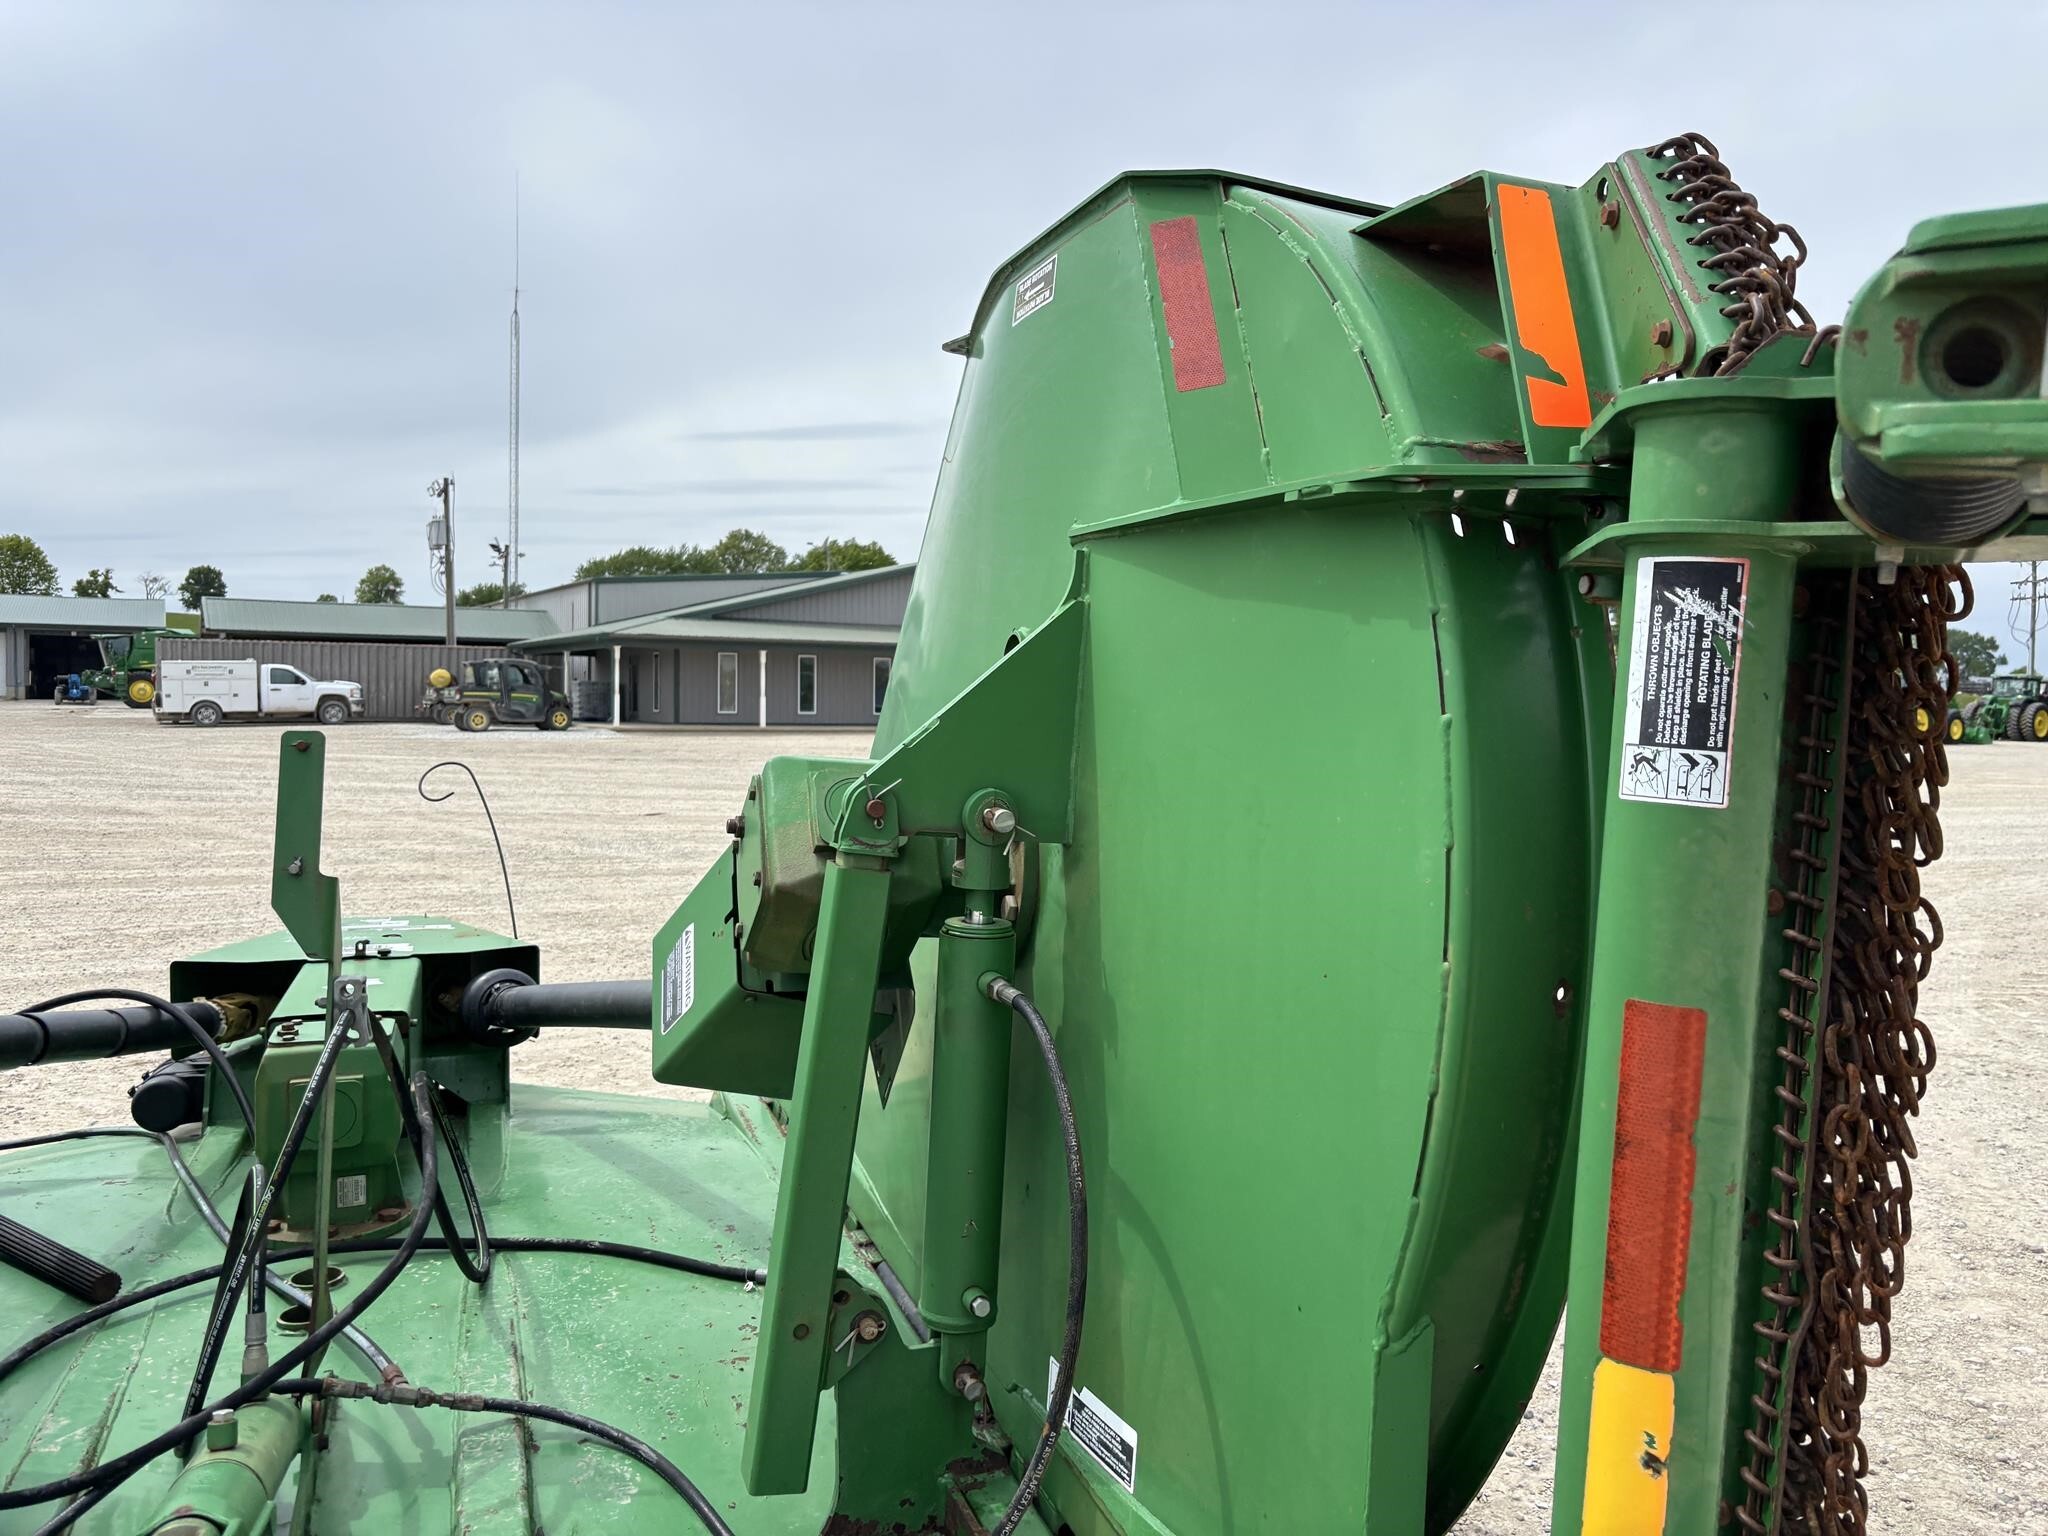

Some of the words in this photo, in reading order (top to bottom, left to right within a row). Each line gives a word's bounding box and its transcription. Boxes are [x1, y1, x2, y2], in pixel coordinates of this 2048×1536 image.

[1651, 604, 1663, 652] OBJECTS
[1673, 622, 1679, 630] of
[1680, 621, 1689, 654] Including
[1702, 607, 1714, 649] BLADE
[1670, 631, 1679, 666] hundreds
[1647, 655, 1658, 701] THROWN
[1656, 732, 1662, 743] Do
[1659, 690, 1667, 718] operate
[1663, 620, 1673, 647] people.
[1668, 667, 1676, 693] thrown
[1678, 656, 1686, 678] place.
[1686, 669, 1692, 677] at
[1697, 651, 1710, 703] ROTATING
[1708, 736, 1715, 747] Do
[1715, 675, 1720, 683] or
[1720, 587, 1728, 609] cutter
[1668, 694, 1673, 704] be
[1674, 687, 1682, 714] shields
[1683, 678, 1693, 708] opening
[1720, 676, 1729, 704] running
[1680, 709, 1690, 745] discharge
[1718, 705, 1727, 730] engine
[1672, 725, 1680, 745] Keep
